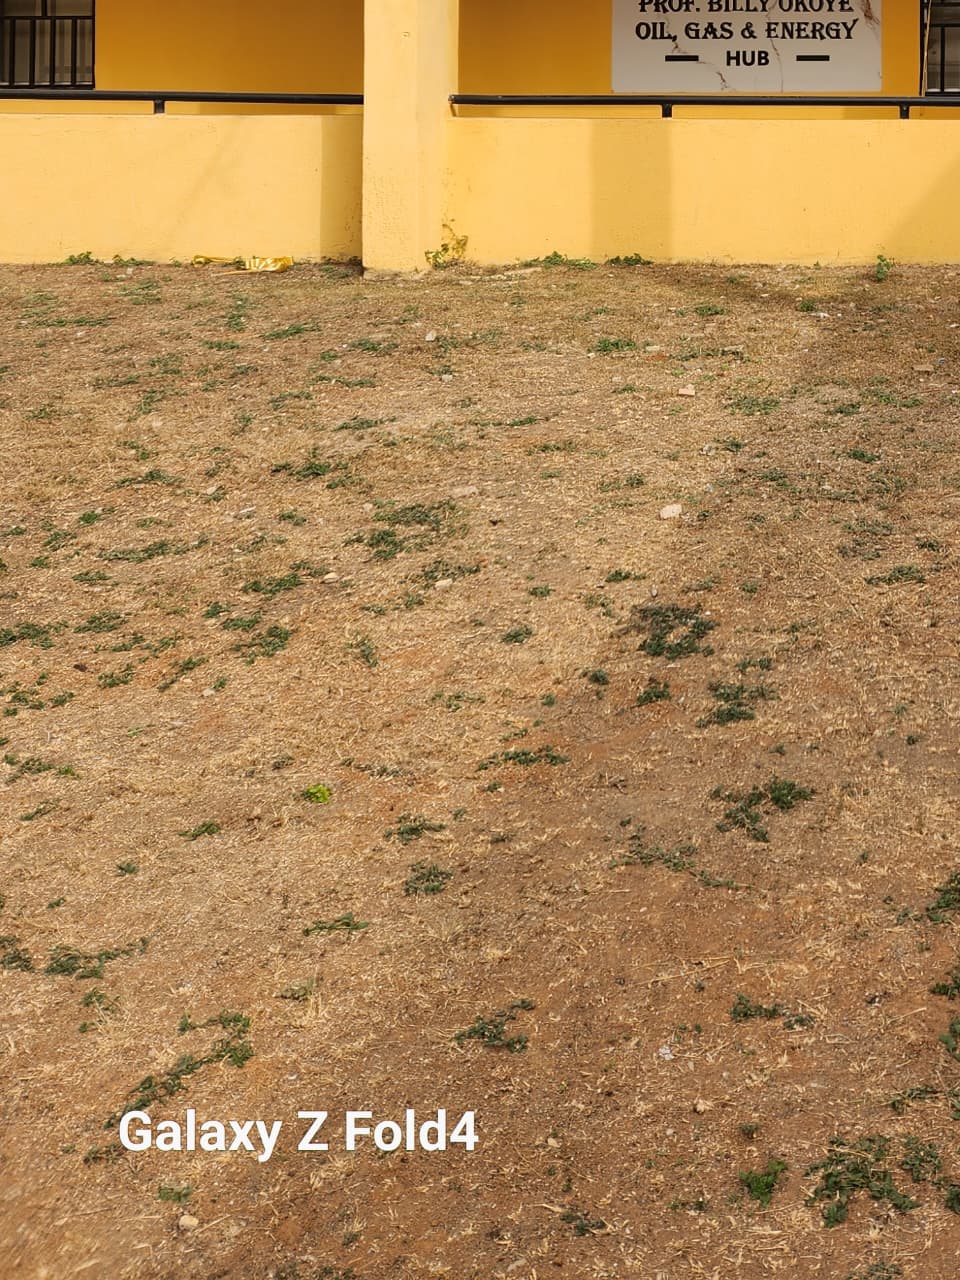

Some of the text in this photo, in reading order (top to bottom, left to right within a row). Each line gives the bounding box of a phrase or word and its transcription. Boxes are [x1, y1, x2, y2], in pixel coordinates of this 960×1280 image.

[635, 18, 859, 42] OIL, GAS & ENERGY
[726, 51, 769, 66] HUB
